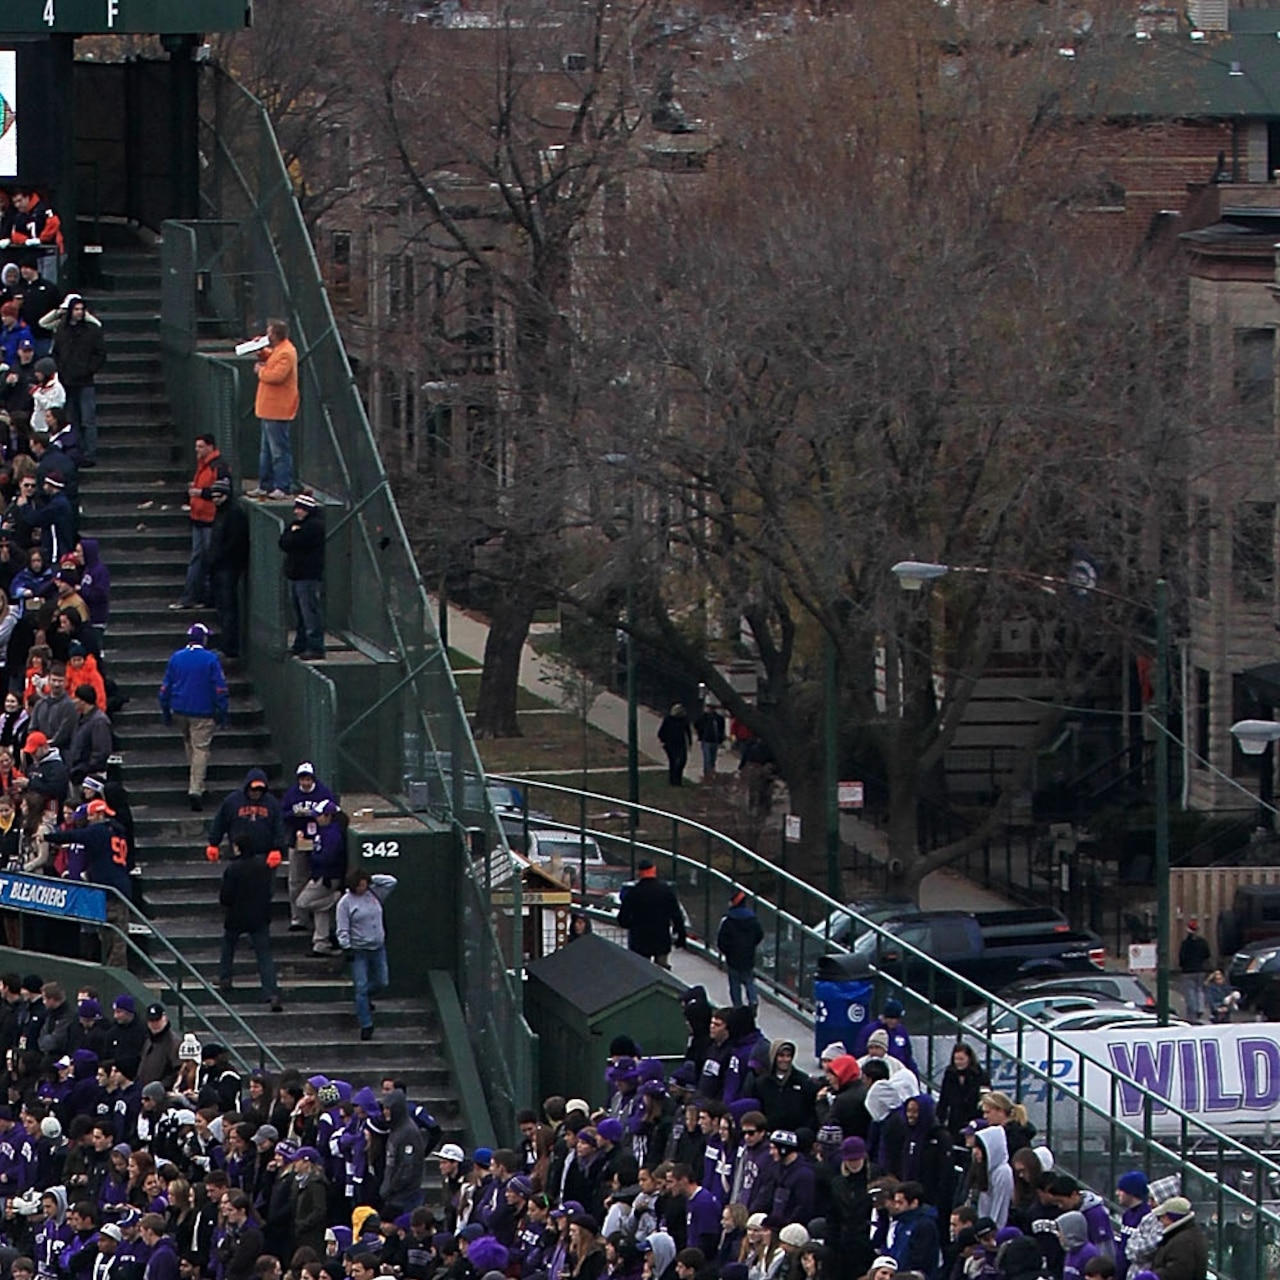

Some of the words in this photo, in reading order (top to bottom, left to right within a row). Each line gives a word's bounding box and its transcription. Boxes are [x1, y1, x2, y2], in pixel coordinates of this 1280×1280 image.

[42, 0, 54, 27] 4
[107, 0, 119, 28] F
[361, 841, 400, 859] 342
[10, 882, 68, 908] BLEACHERS
[1108, 1038, 1280, 1117] WILD
